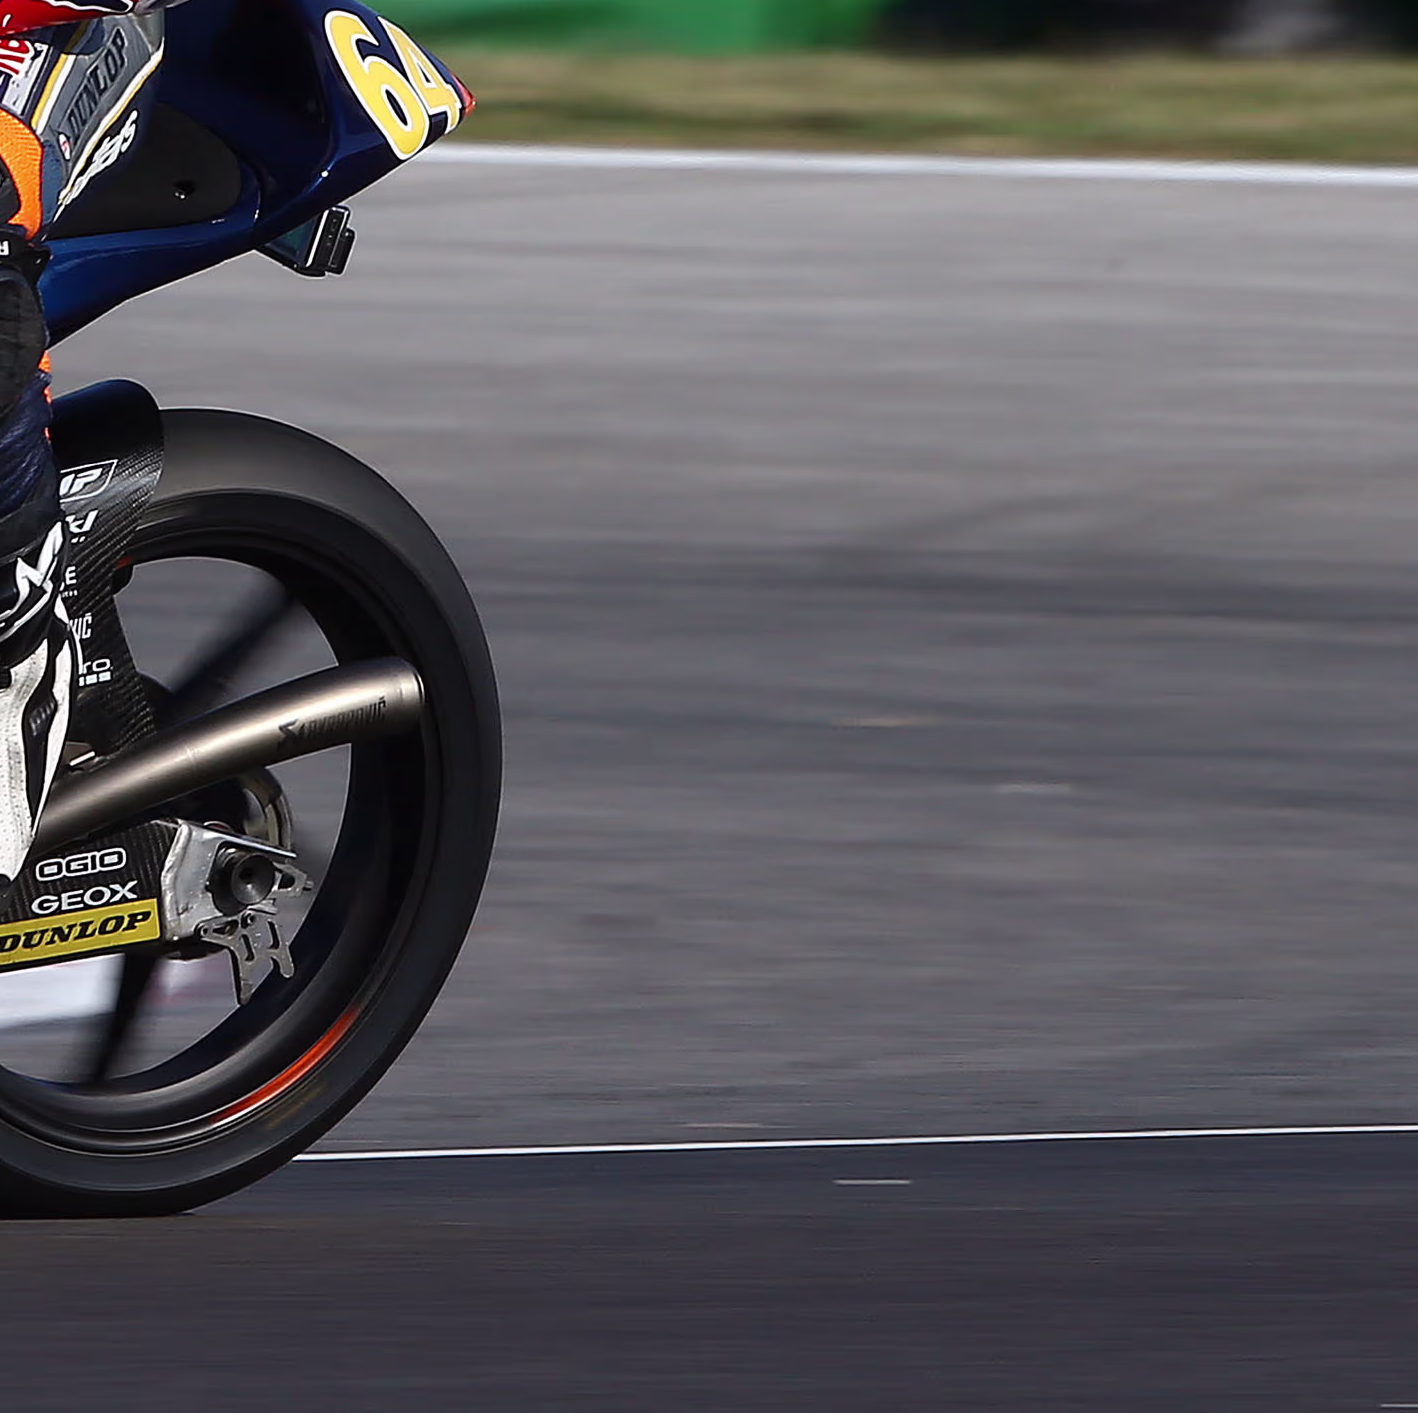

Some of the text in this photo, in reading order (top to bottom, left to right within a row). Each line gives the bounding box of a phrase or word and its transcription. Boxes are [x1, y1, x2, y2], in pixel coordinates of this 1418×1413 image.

[68, 27, 127, 138] DUNLOP
[324, 10, 463, 161] 64
[31, 880, 138, 914] GEOX
[36, 848, 126, 881] OGIO
